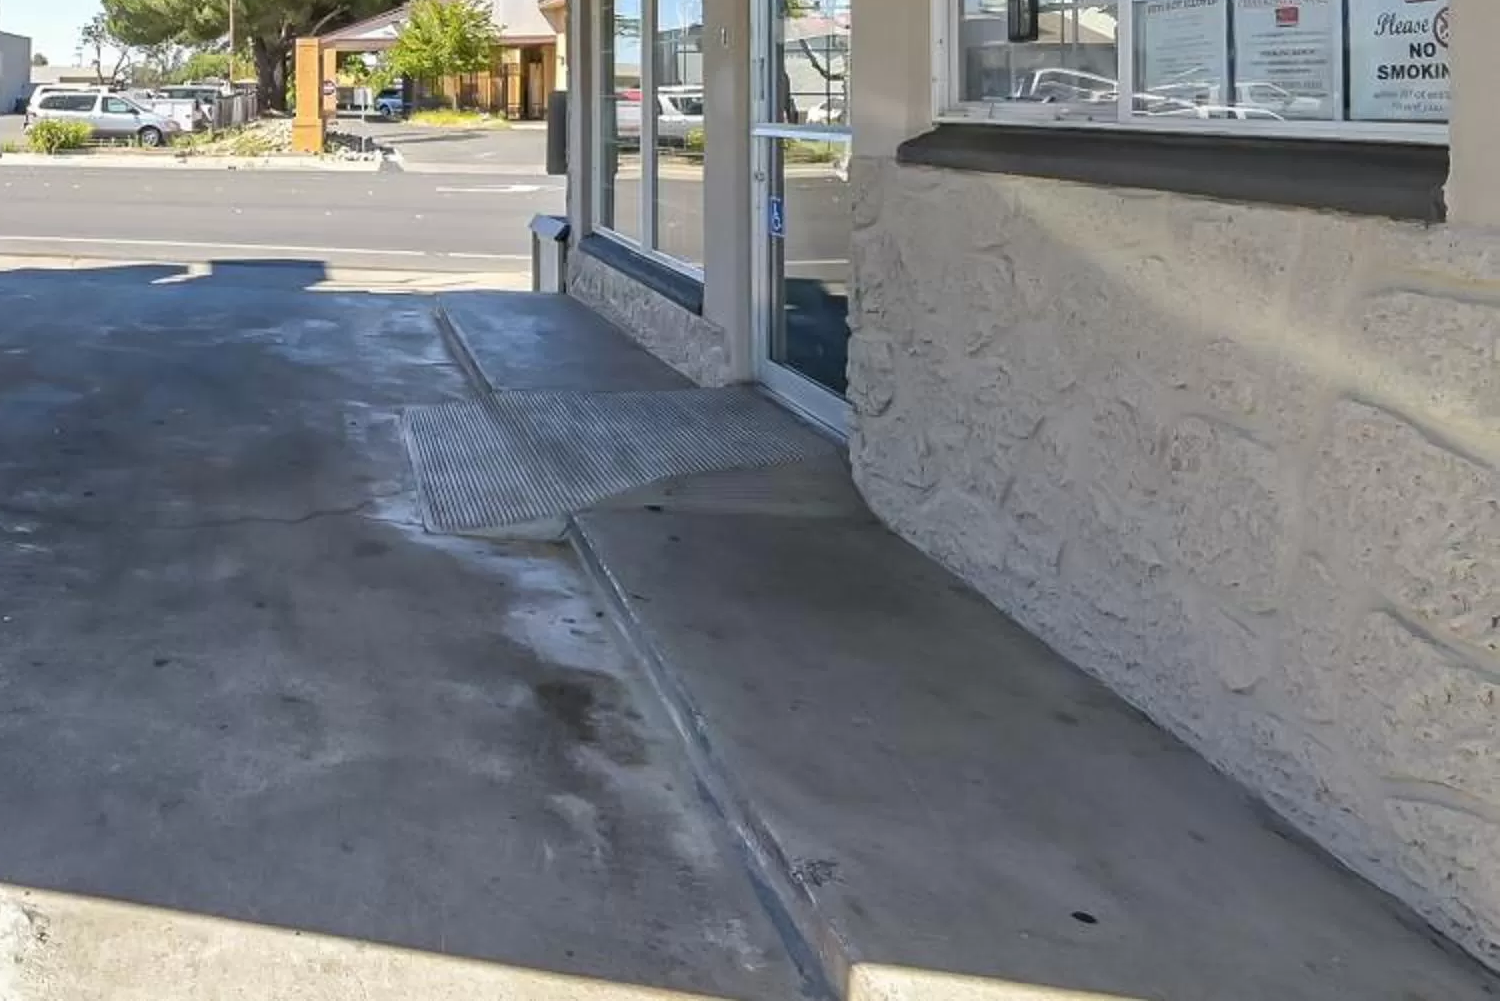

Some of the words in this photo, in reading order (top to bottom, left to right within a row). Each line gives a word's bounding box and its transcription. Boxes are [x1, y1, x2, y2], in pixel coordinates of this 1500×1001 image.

[1373, 10, 1430, 37] Please
[1409, 42, 1437, 59] NO
[1376, 63, 1450, 81] SMOKIN
